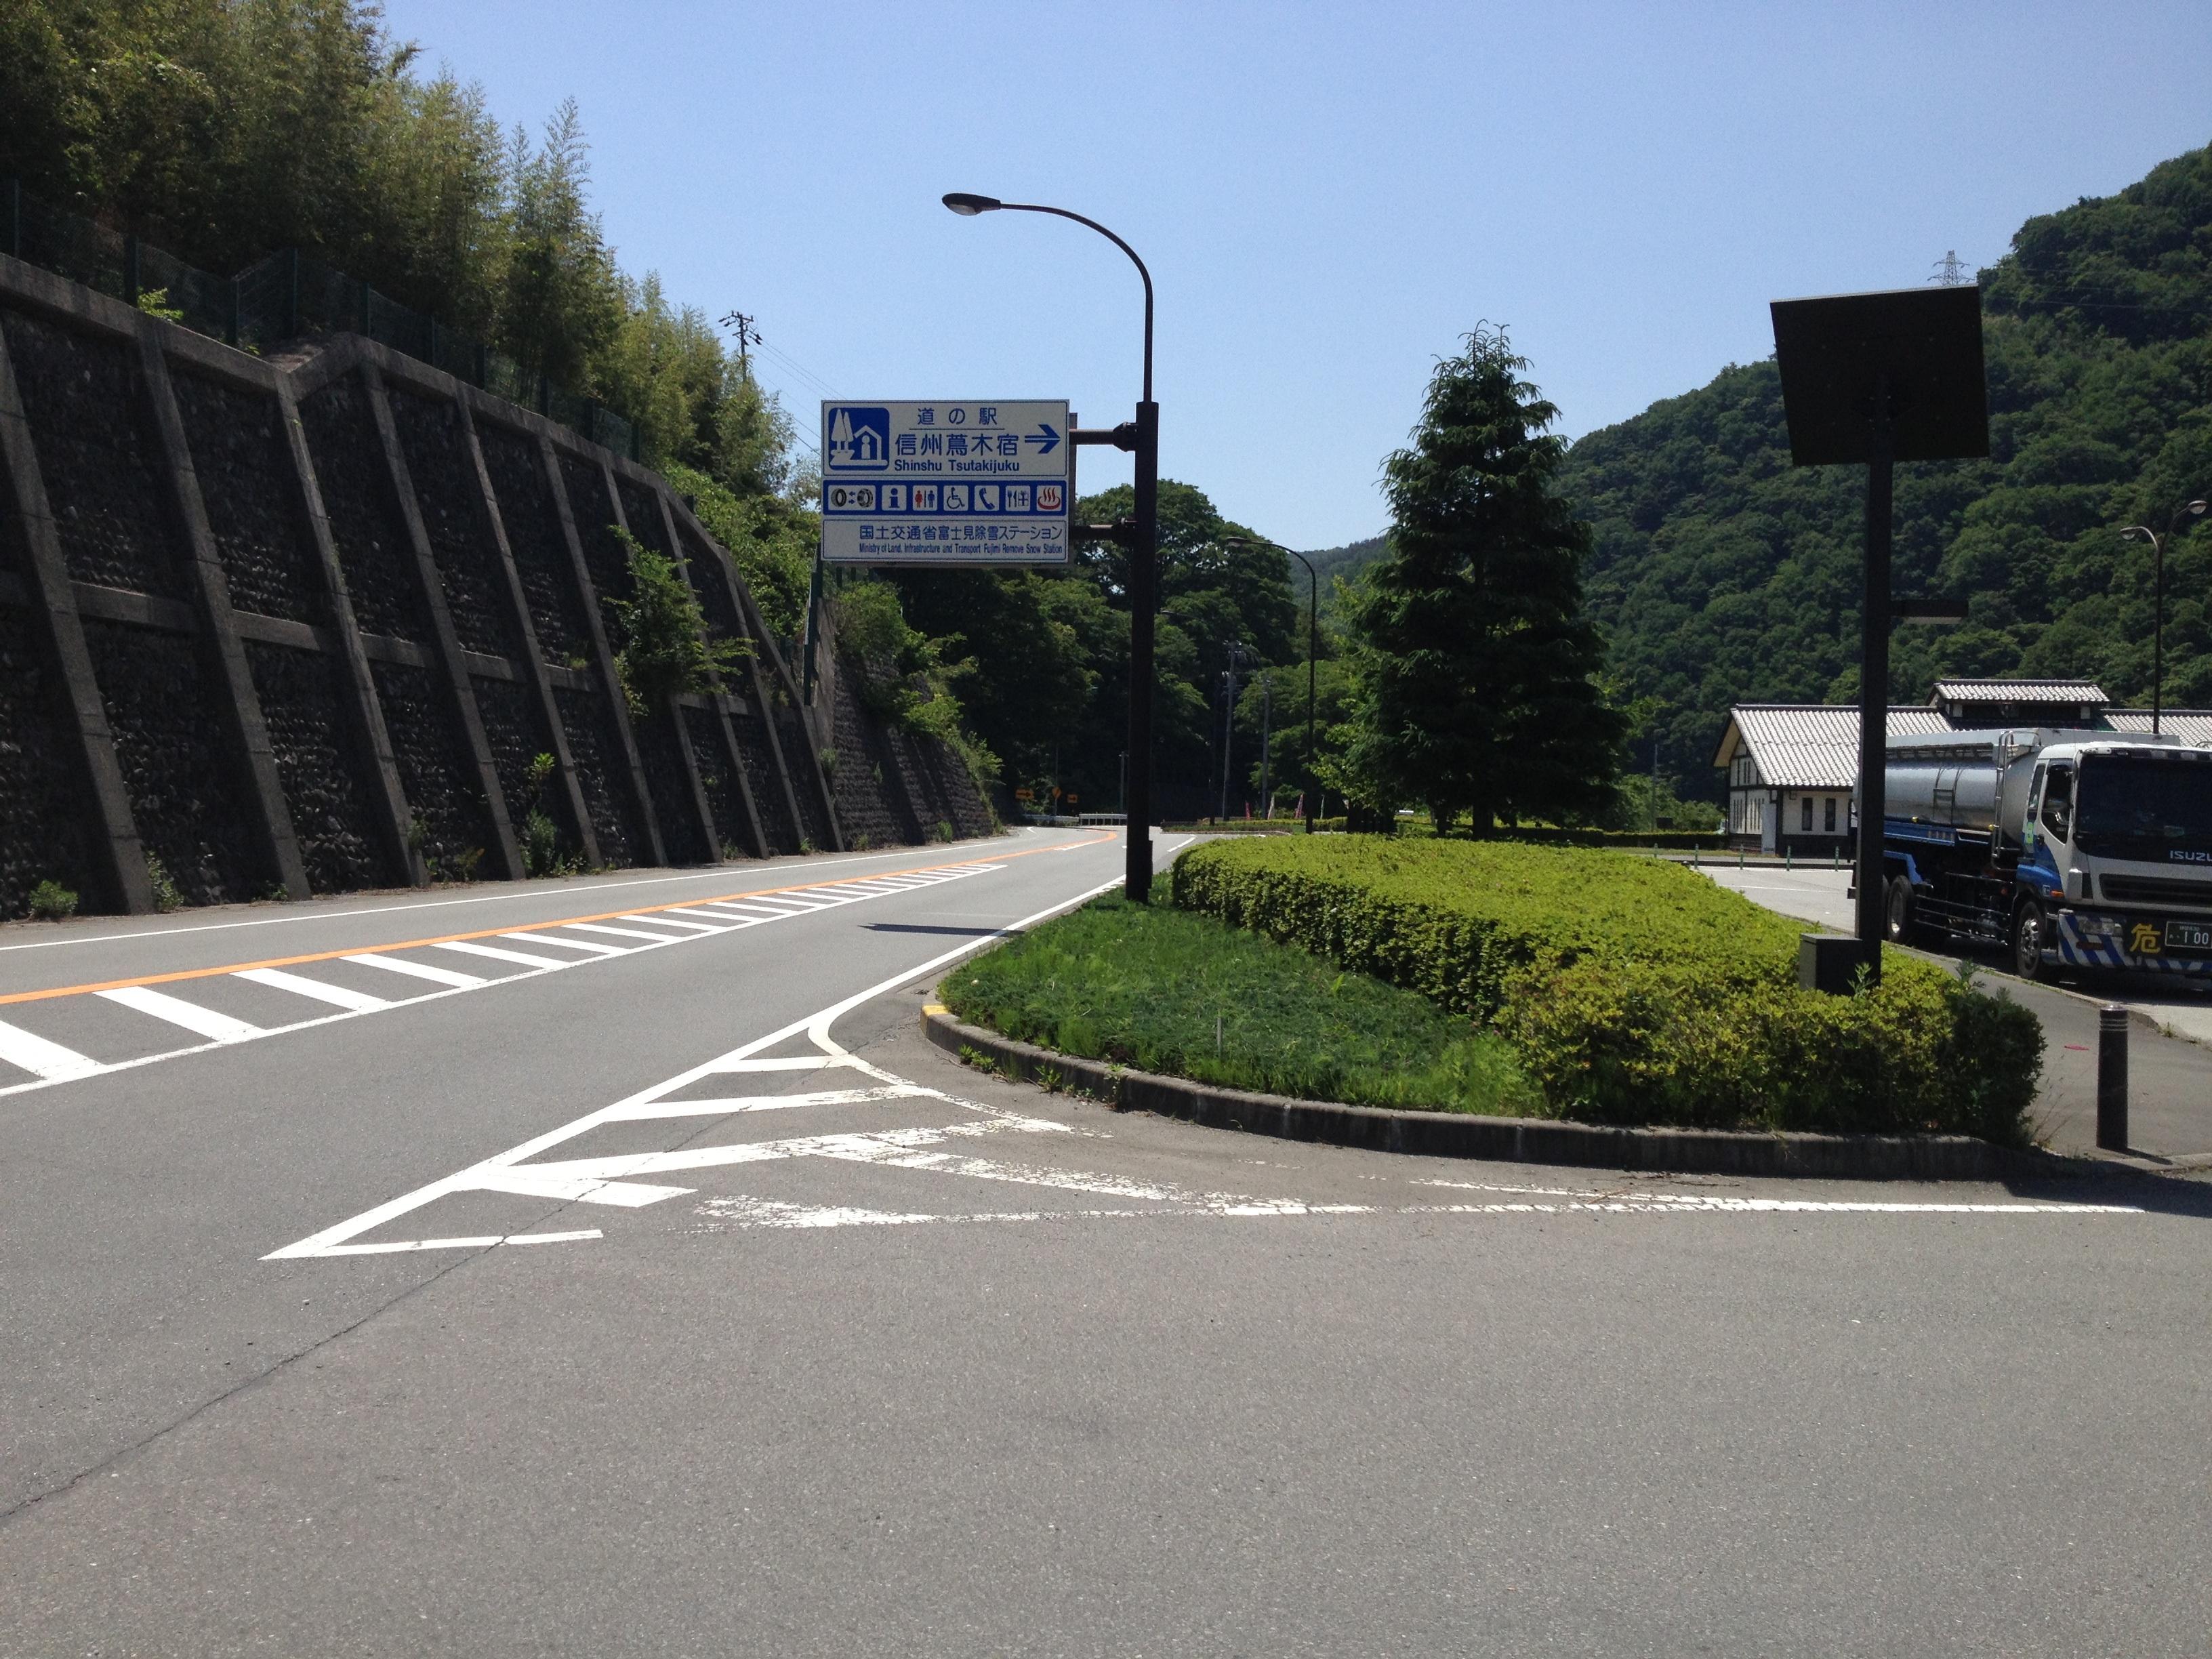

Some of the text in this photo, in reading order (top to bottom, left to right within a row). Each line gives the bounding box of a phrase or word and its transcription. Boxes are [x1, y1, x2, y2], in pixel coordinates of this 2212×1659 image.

[918, 407, 998, 425] 道の駅
[895, 433, 1019, 456] 信州蔦木宿
[894, 459, 1020, 474] Shinshu Tsutakijuku
[859, 525, 1063, 541] 国土交通省富士見除雪ステーション
[859, 543, 880, 555] Ministry
[881, 543, 887, 553] of
[904, 543, 941, 553] Infrastructure
[942, 544, 953, 553] and
[955, 544, 981, 554] Transport
[983, 544, 1000, 555] Fujimi
[1002, 544, 1024, 554] Remove
[1026, 544, 1041, 554] Snow
[1043, 544, 1063, 554] Station
[2129, 923, 2162, 954] 危
